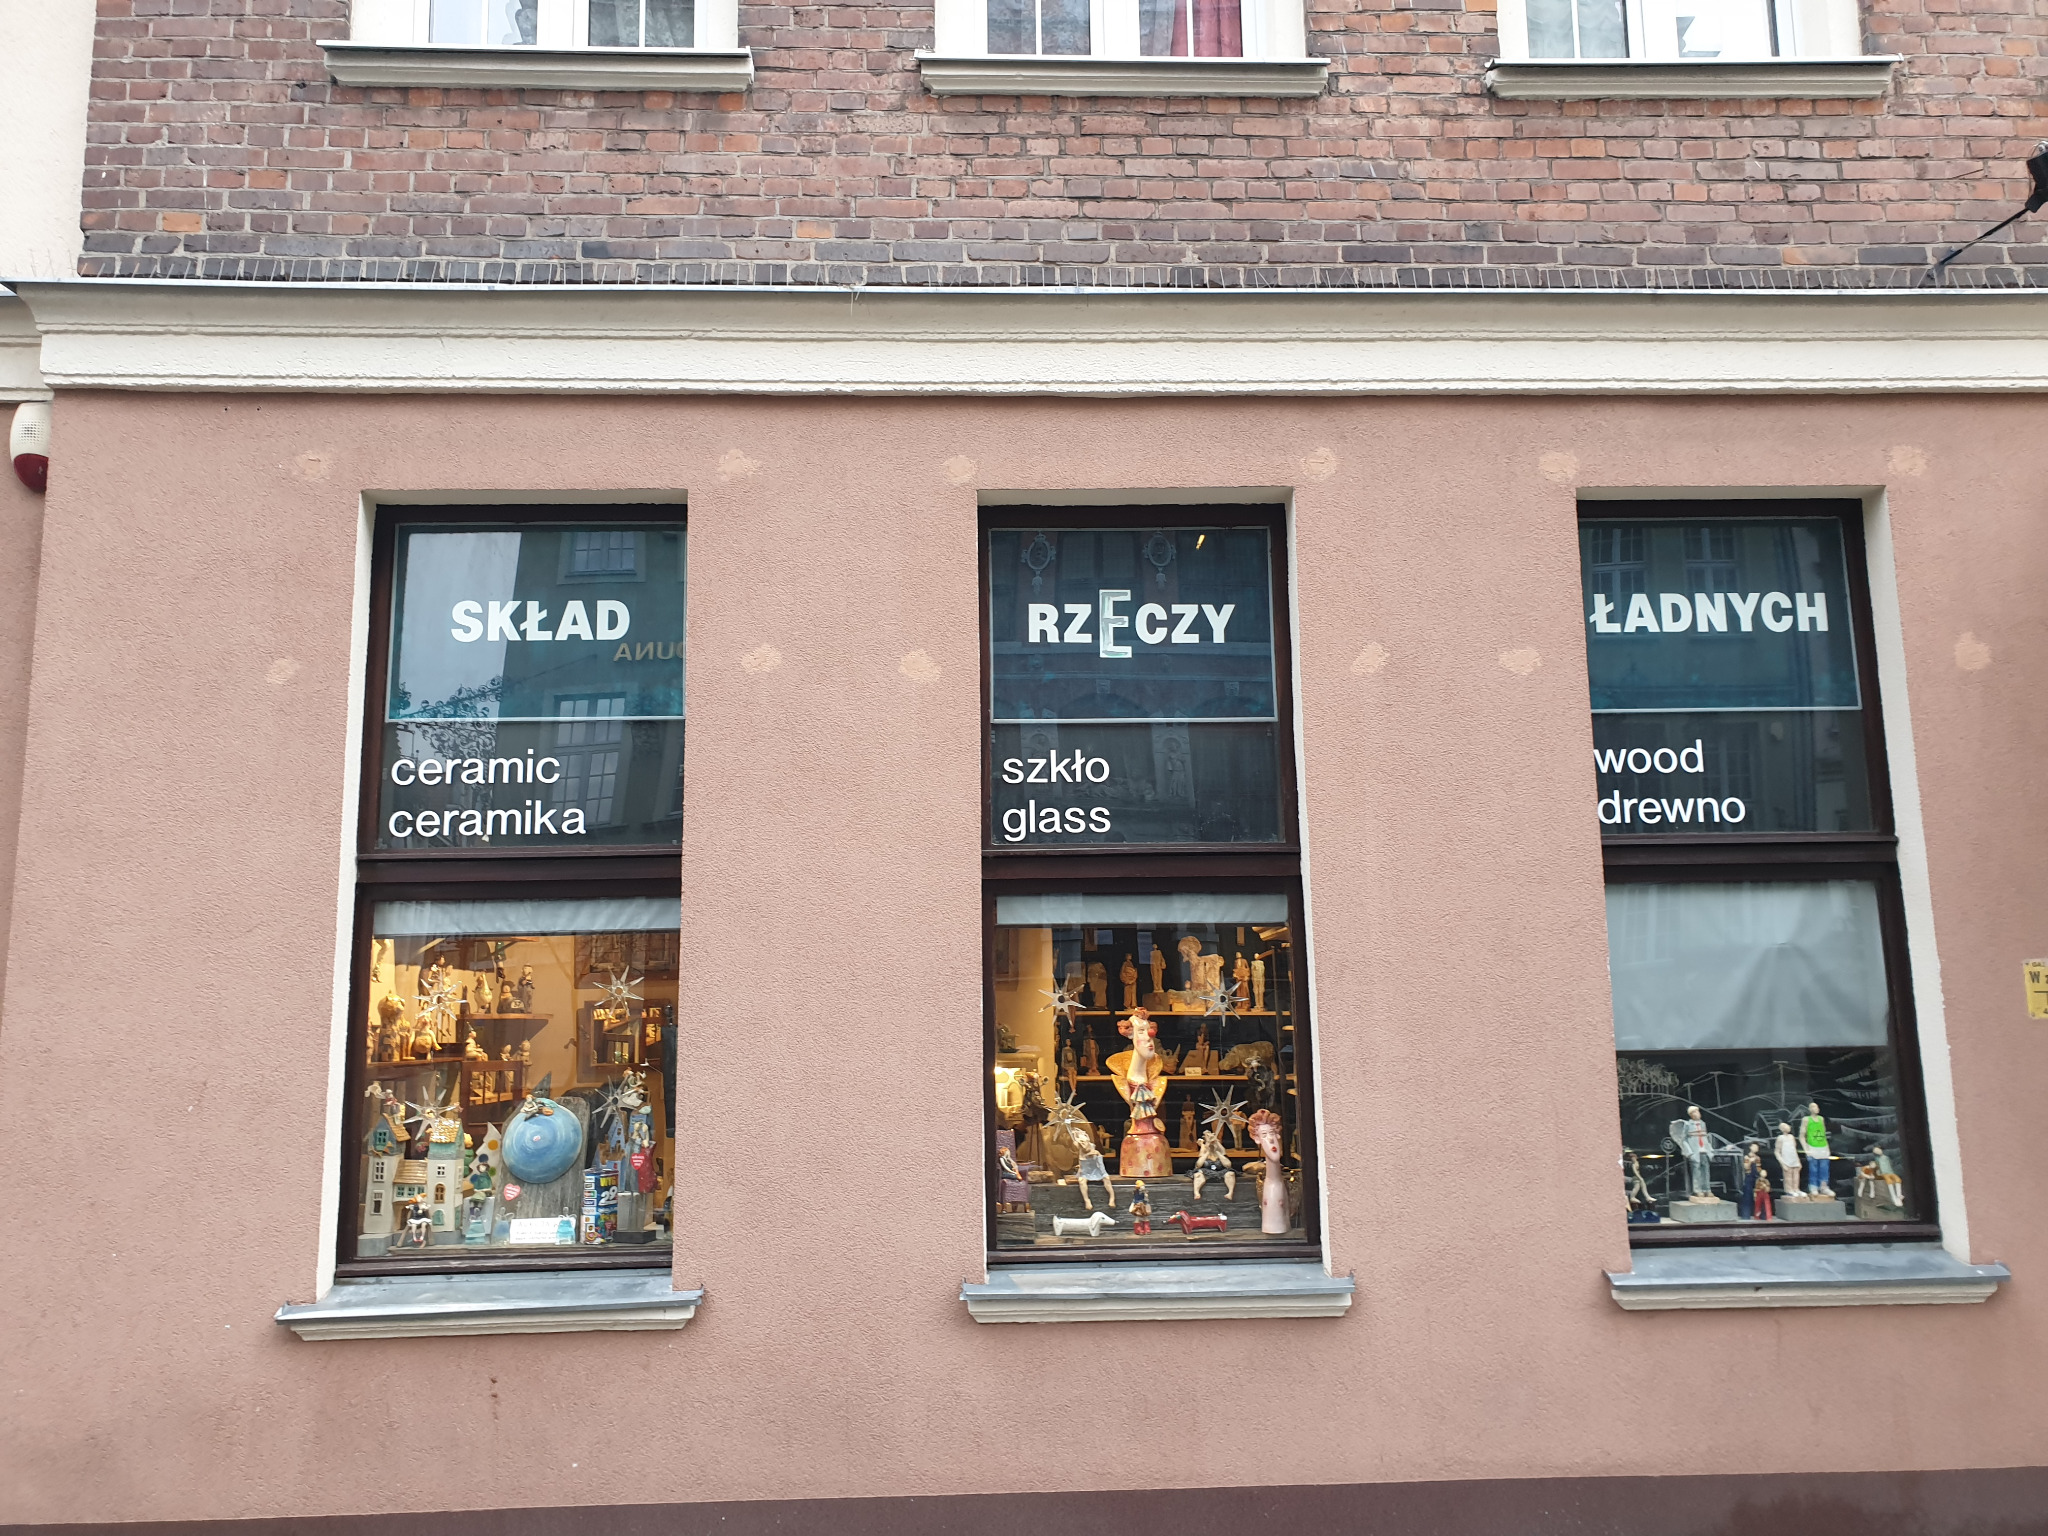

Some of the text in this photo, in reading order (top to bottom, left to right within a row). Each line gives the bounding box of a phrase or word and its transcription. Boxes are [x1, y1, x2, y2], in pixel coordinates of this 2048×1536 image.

[451, 600, 630, 643] SKŁAD
[1028, 589, 1236, 659] RZECZY
[1588, 591, 1830, 634] ŁADNYCH
[390, 749, 561, 786] ceramic
[1002, 749, 1110, 784] szkło
[1594, 738, 1705, 774] wood
[388, 800, 587, 838] ceramika
[1002, 799, 1112, 842] glass
[1597, 790, 1747, 824] drewno
